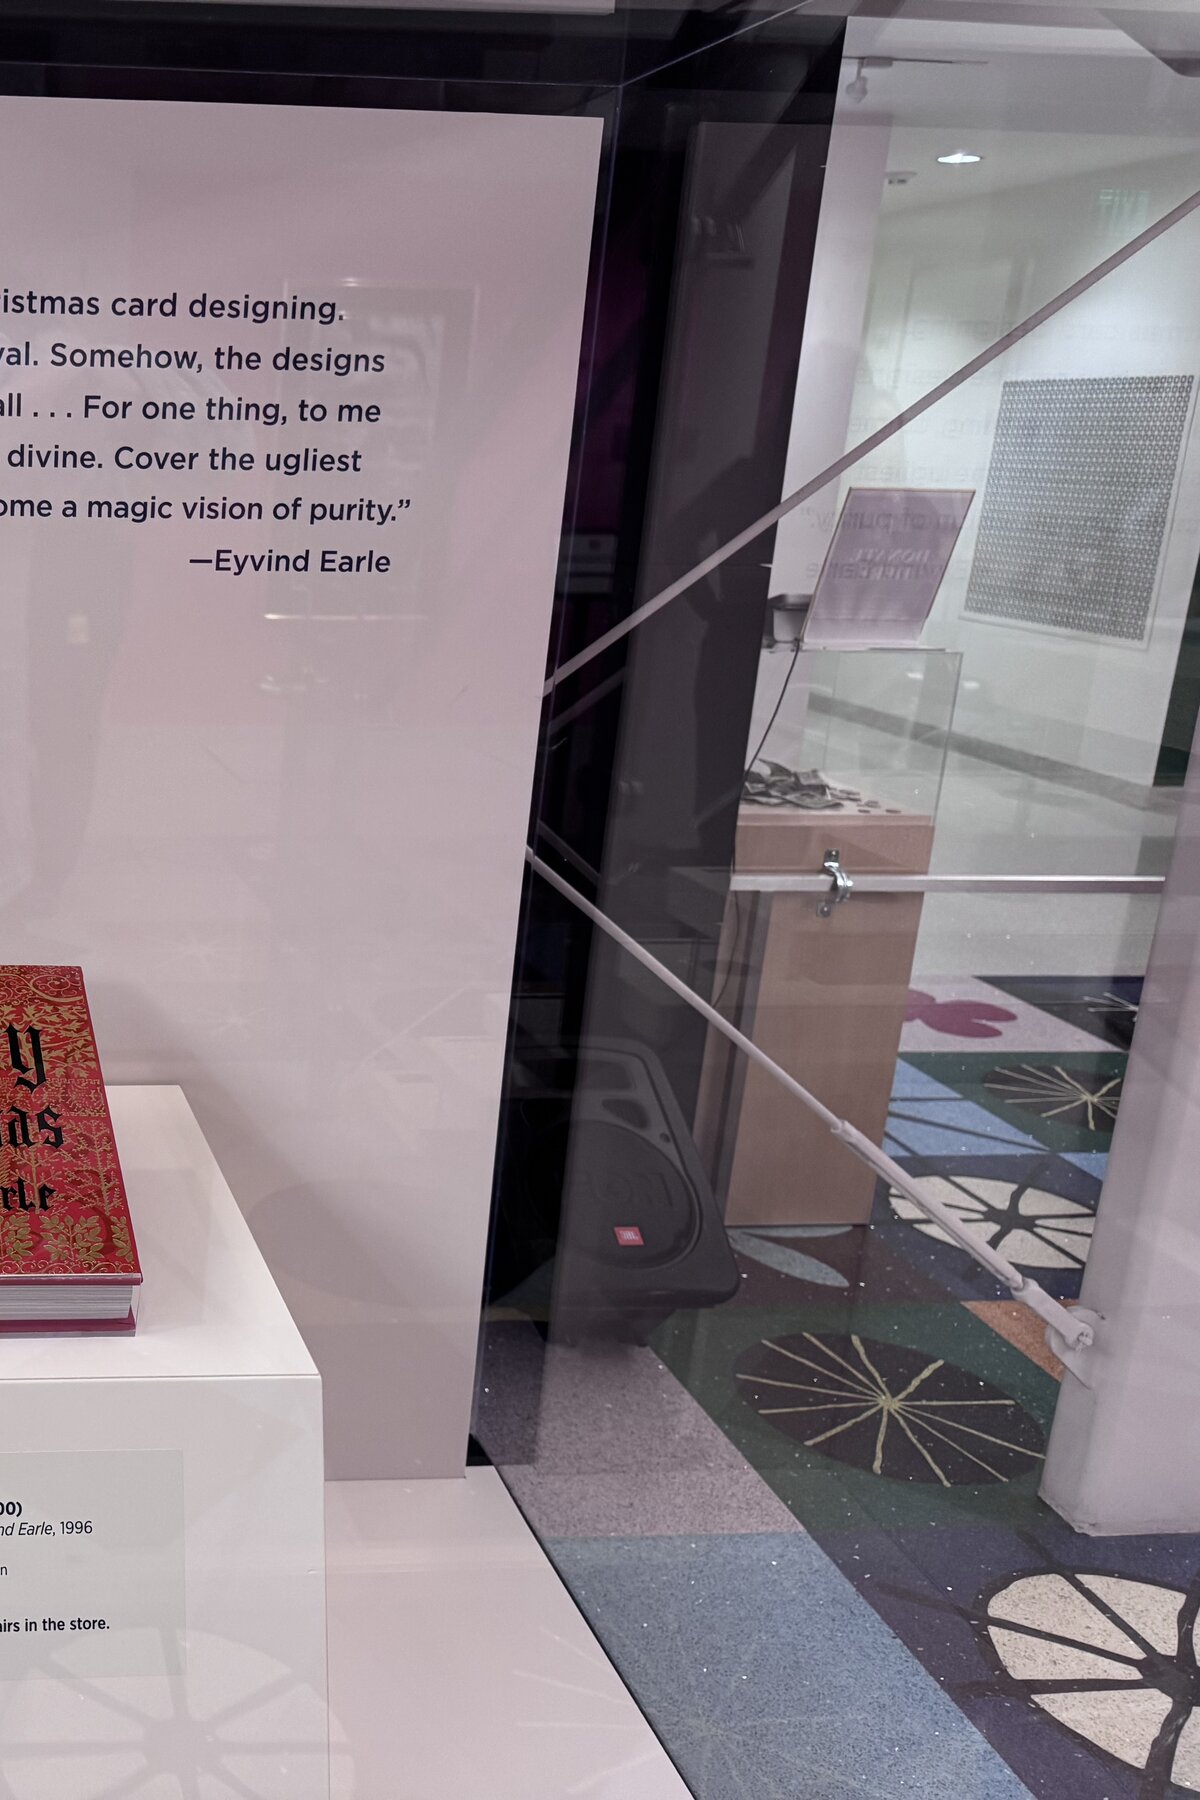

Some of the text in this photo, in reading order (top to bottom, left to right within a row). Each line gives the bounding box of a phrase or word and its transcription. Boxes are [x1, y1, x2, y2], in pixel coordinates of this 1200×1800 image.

[111, 291, 178, 318] card
[188, 292, 344, 326] designing.
[50, 342, 203, 374] Somehow,
[214, 345, 262, 371] the
[271, 345, 385, 377] designs
[83, 394, 133, 420] For
[141, 400, 196, 421] one
[205, 396, 288, 427] thing,
[297, 398, 328, 423] to
[337, 403, 382, 423] me
[7, 443, 103, 469] divine.
[114, 445, 200, 471] Cover
[208, 446, 255, 472] the
[265, 447, 363, 477] ugliest
[61, 499, 77, 518] a
[87, 495, 173, 524] magic
[181, 495, 263, 520] vision
[272, 496, 303, 521] of
[319, 549, 391, 574] Earle
[16, 1521, 56, 1537] Earle,
[59, 1520, 93, 1535] 1996
[24, 1618, 38, 1633] in
[41, 1617, 66, 1632] the
[69, 1617, 110, 1631] store.
